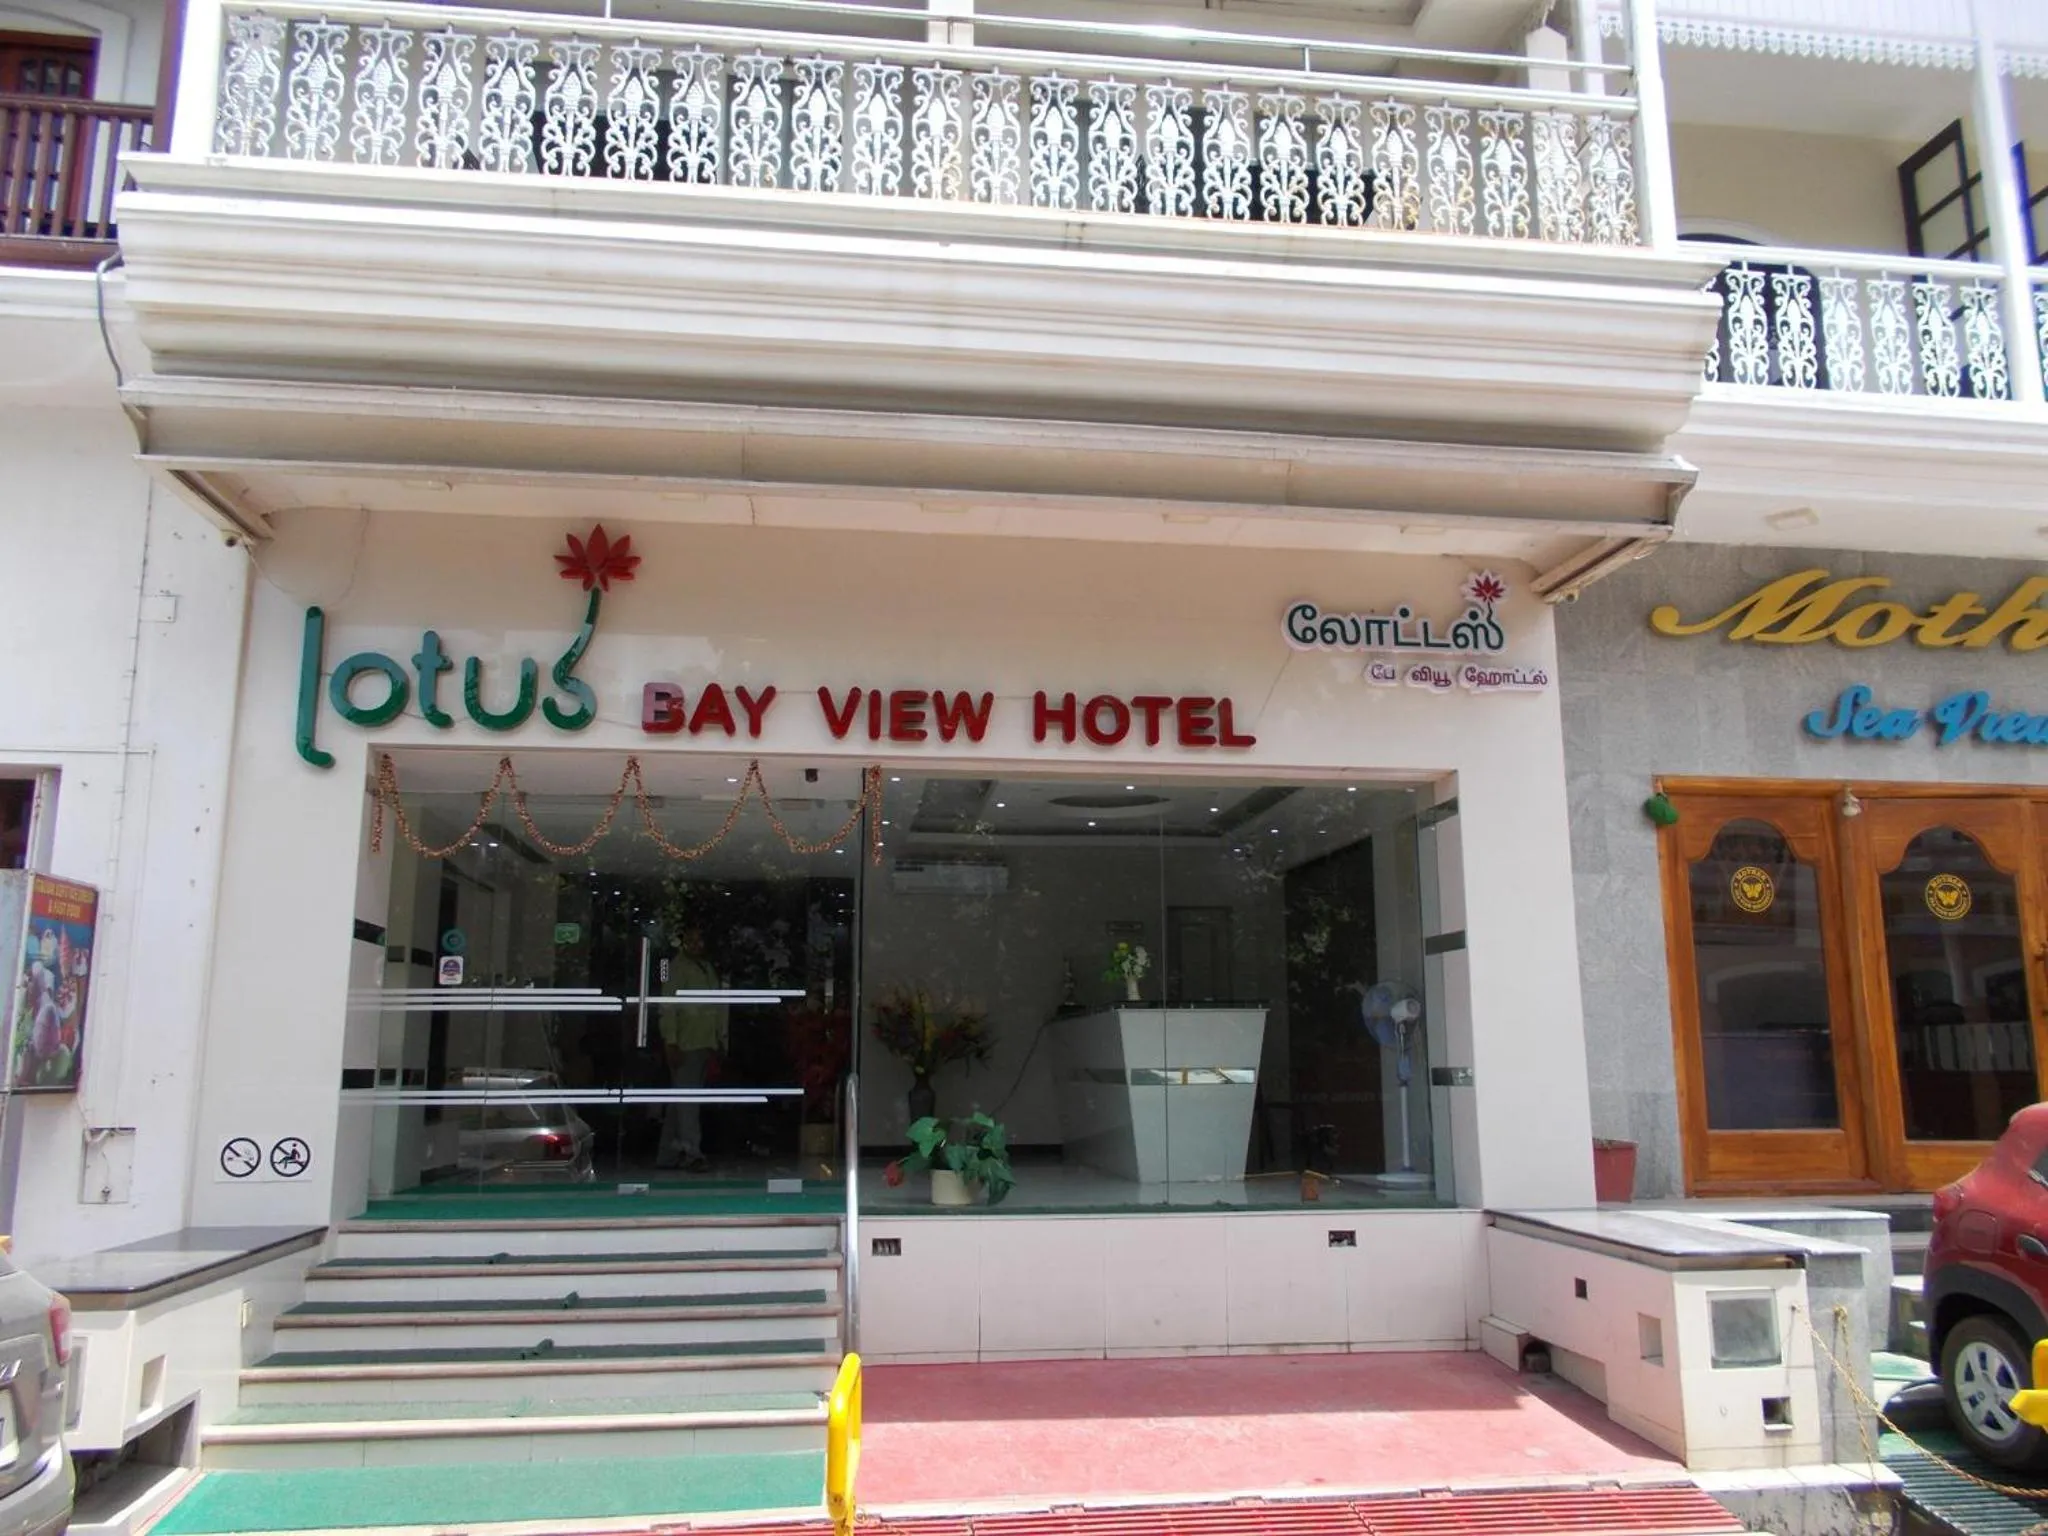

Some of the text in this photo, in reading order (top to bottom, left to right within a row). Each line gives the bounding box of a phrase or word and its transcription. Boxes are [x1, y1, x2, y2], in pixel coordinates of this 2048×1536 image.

[1287, 602, 1504, 651] லோட்டஸ்
[1371, 664, 1395, 681] பே
[1411, 666, 1452, 688] வியூ
[641, 682, 776, 739] BAY
[817, 685, 995, 742] VIEW
[1032, 691, 1257, 748] HOTEL
[1804, 683, 1922, 741] Sea
